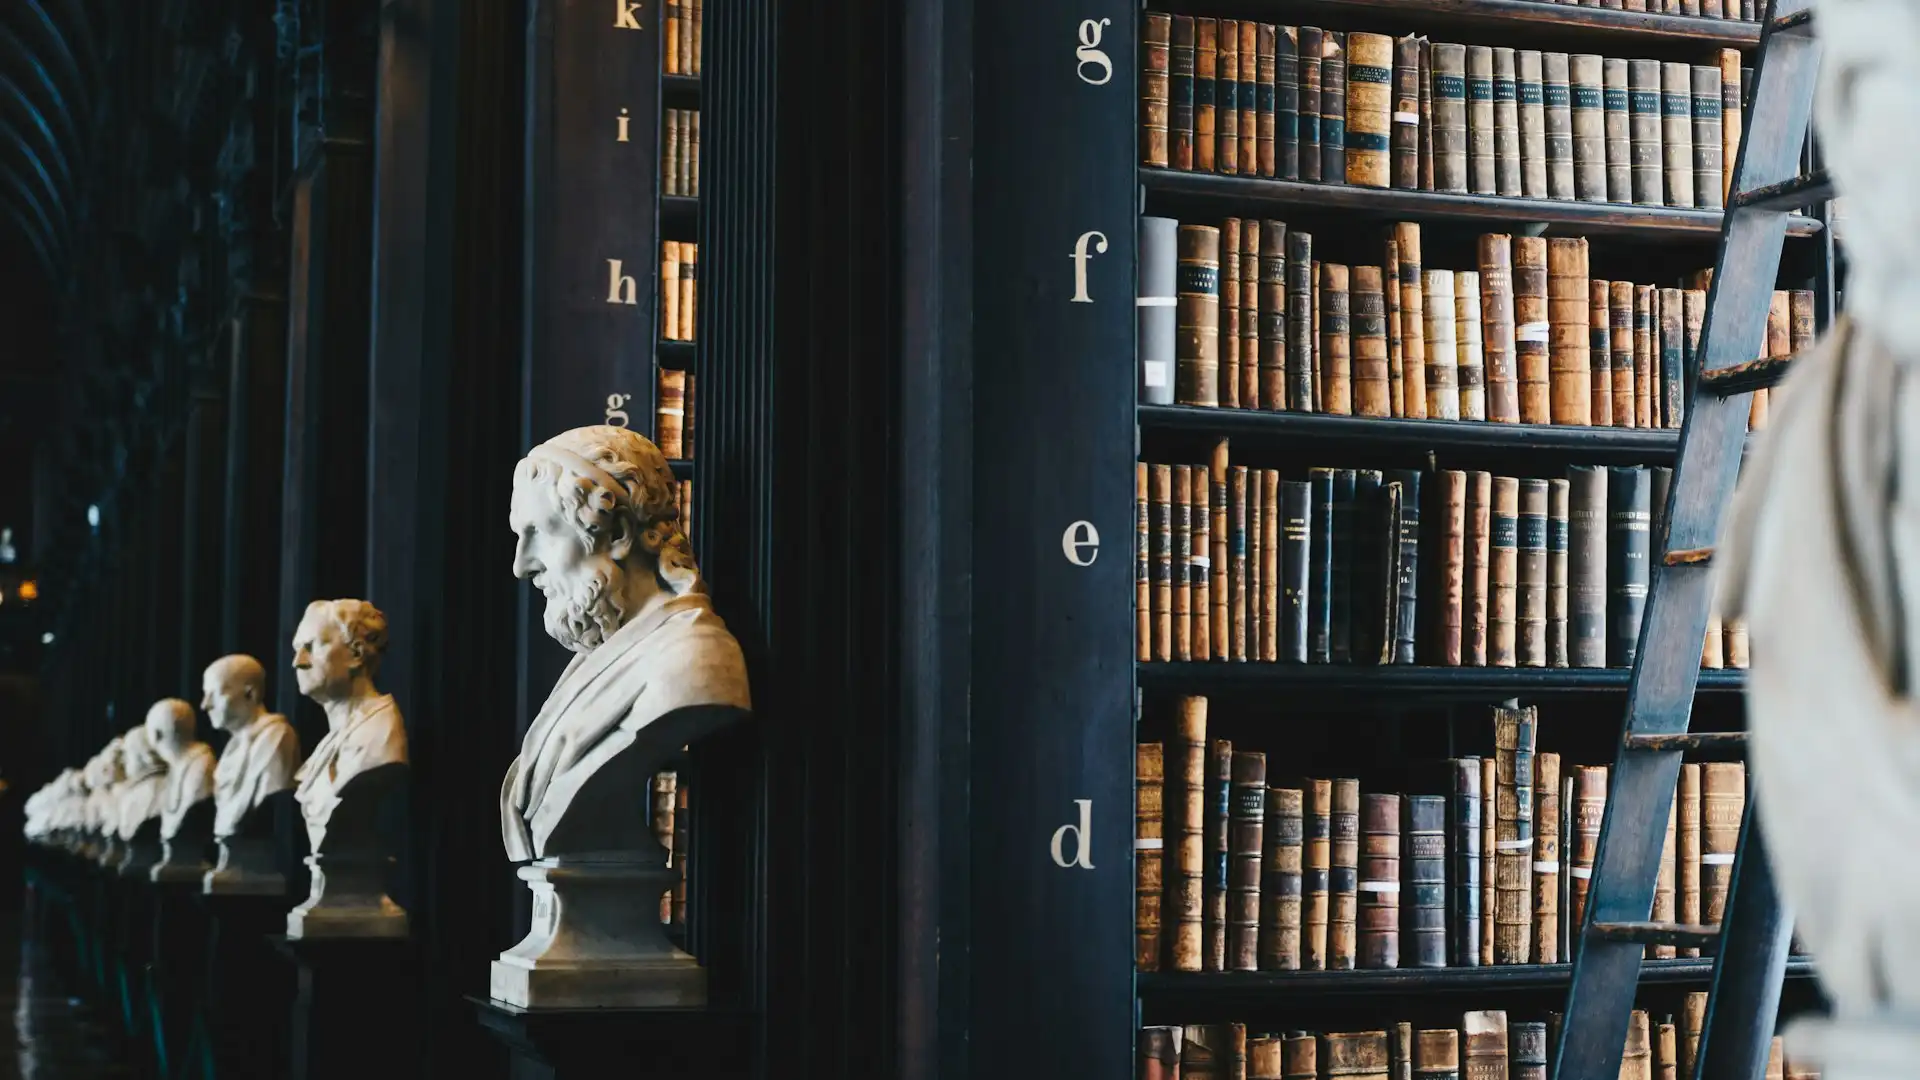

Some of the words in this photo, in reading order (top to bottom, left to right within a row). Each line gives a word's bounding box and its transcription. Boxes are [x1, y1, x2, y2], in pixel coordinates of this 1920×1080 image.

[614, 0, 641, 29] k
[1076, 18, 1112, 85] g
[618, 108, 629, 141] i
[607, 259, 637, 304] h
[1069, 231, 1108, 303] f
[605, 393, 632, 428] g
[1063, 520, 1099, 567] e
[1051, 800, 1094, 869] d
